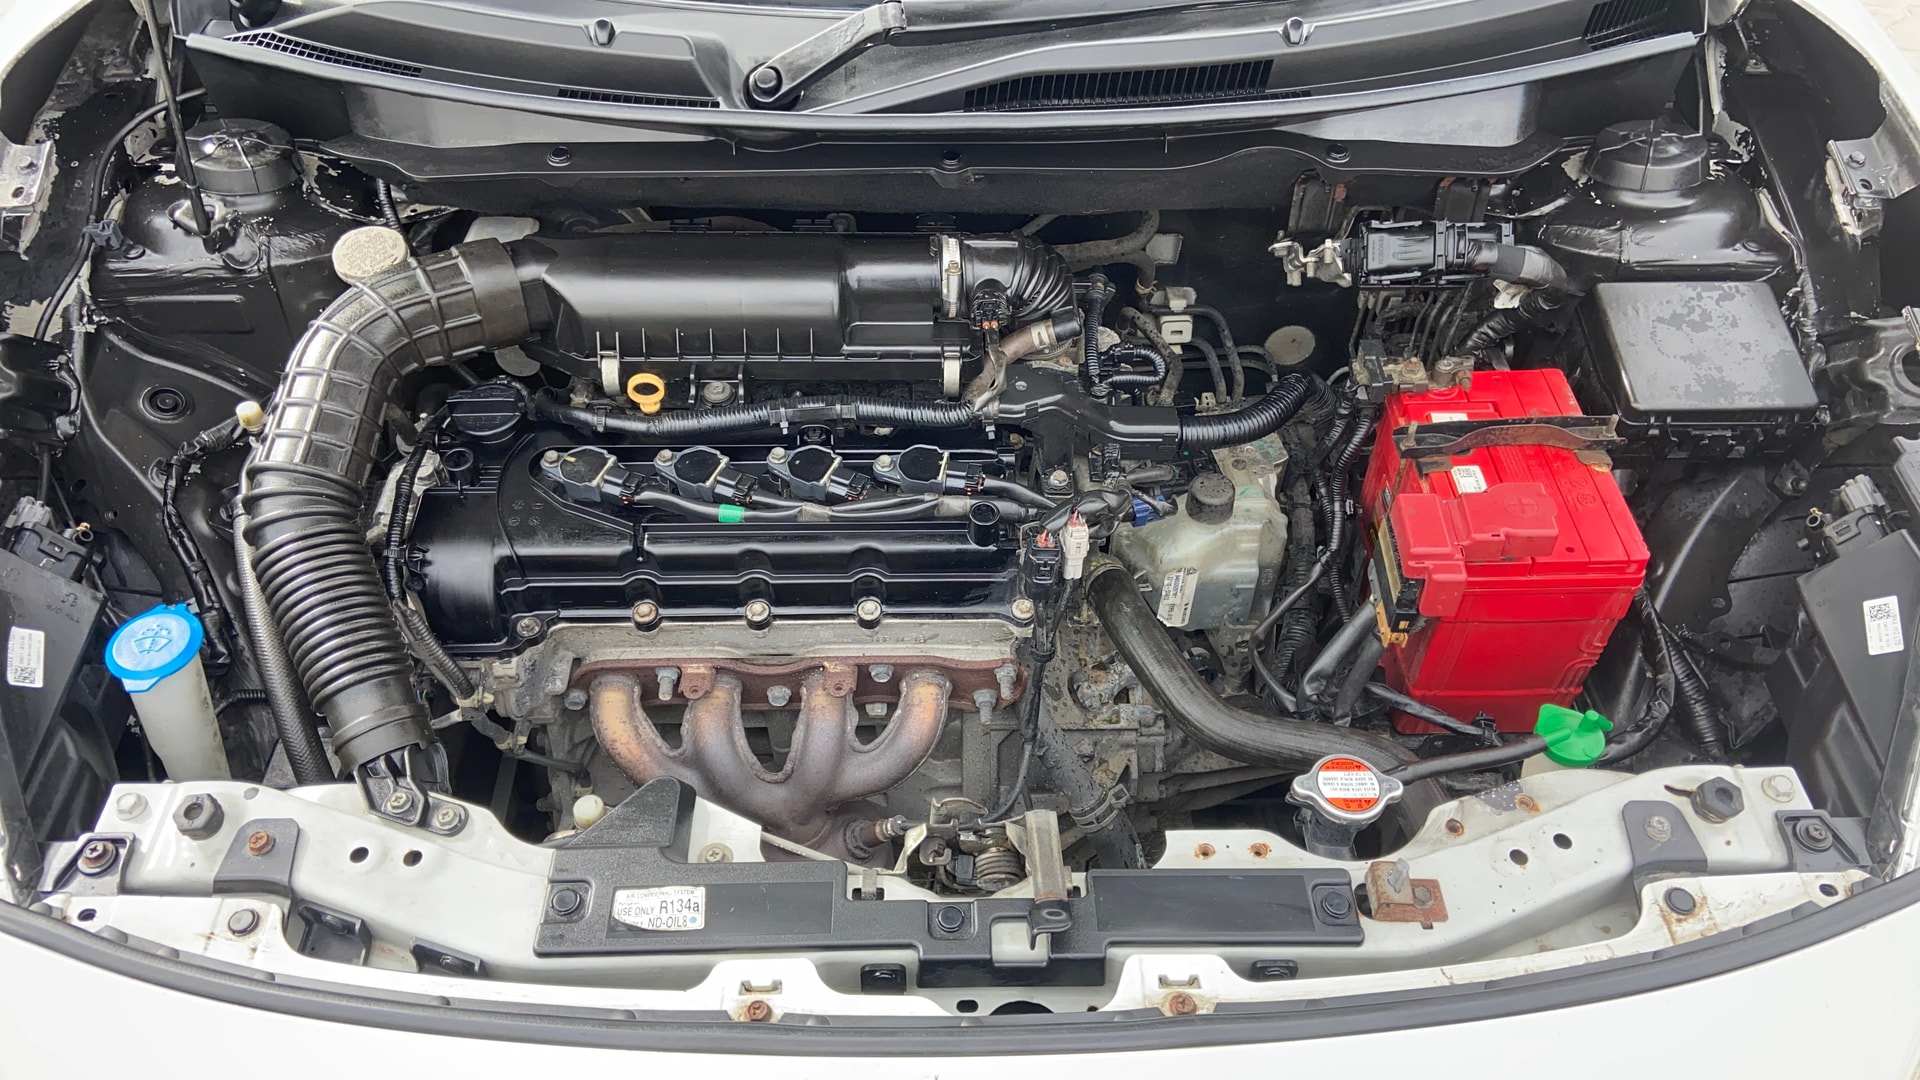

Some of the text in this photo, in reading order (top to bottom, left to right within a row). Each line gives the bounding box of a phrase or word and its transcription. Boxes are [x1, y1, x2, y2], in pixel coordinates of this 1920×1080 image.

[617, 898, 700, 916] USE ONLY R134a
[648, 915, 688, 928] ND-OIL8
